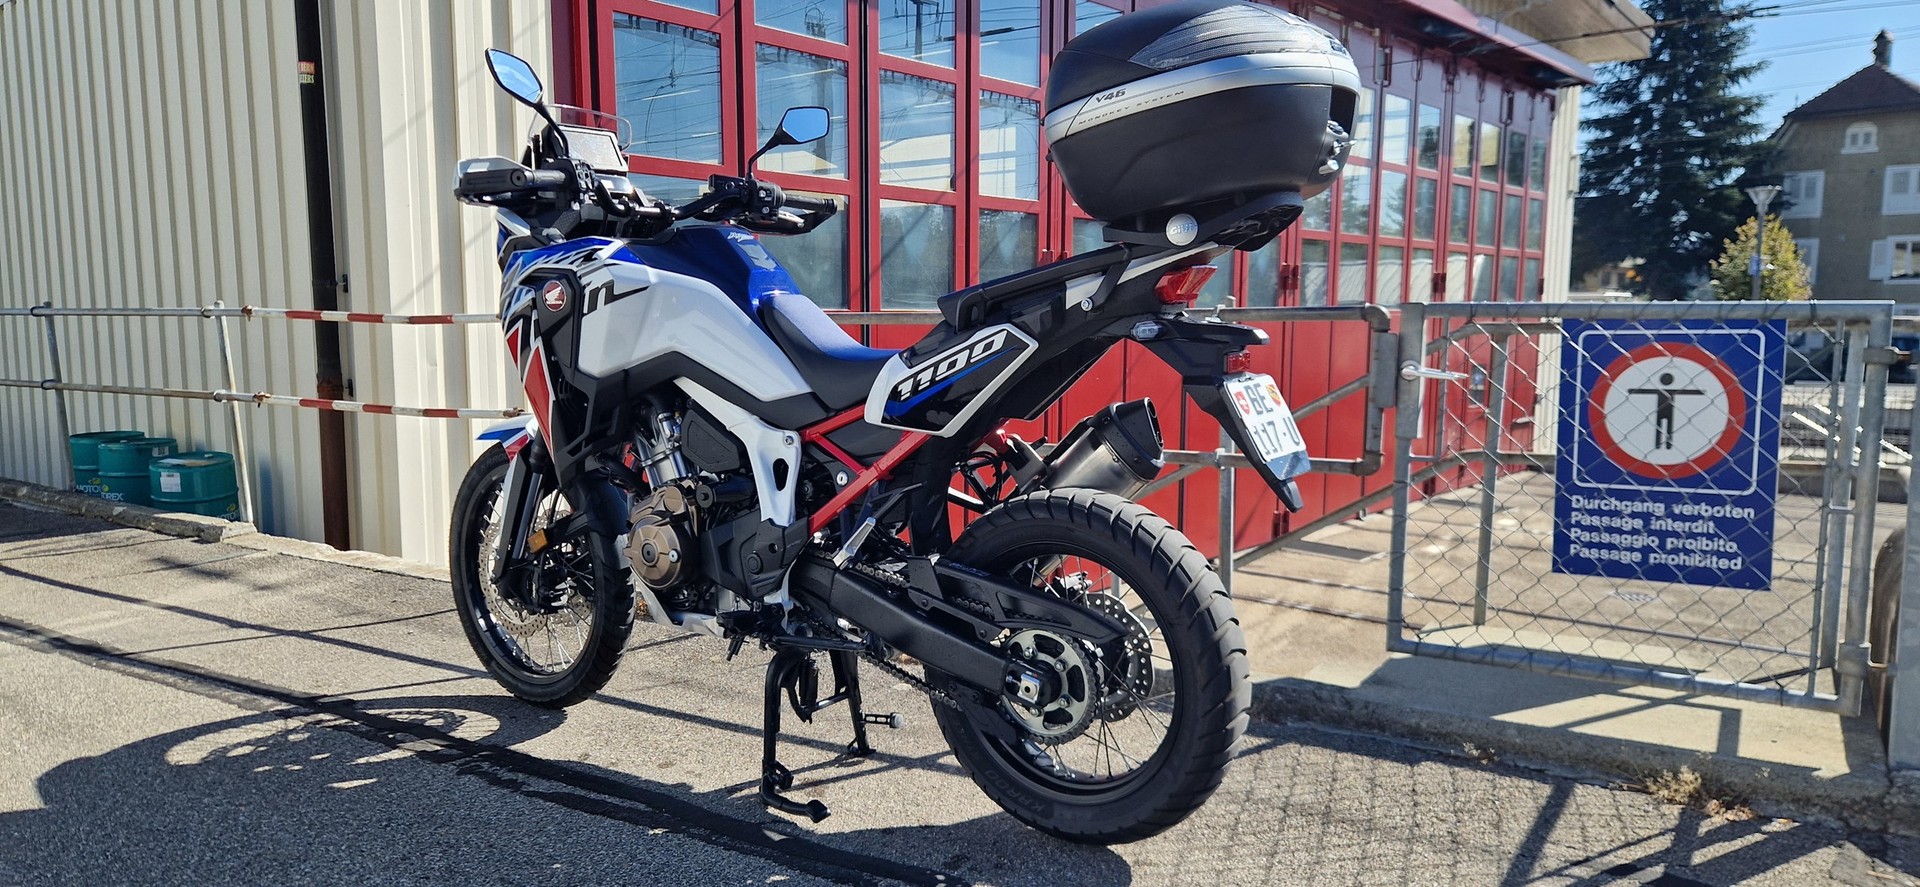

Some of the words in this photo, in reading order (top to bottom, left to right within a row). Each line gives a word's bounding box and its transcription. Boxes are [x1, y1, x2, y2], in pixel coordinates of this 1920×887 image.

[1078, 105, 1130, 125] MONOKEY
[1136, 91, 1184, 106] SYSTEM
[1095, 88, 1127, 104] V46
[897, 329, 1008, 402] 1100
[1243, 383, 1273, 415] BE
[1571, 494, 1666, 517] Durchgang
[1671, 502, 1755, 519] verboten
[1570, 511, 1644, 531] Passage
[1649, 516, 1716, 534] interdit
[1569, 527, 1660, 549] Passaggio
[1666, 536, 1738, 553] proibito
[1569, 543, 1643, 564] Passage
[1648, 552, 1743, 570] prohibited
